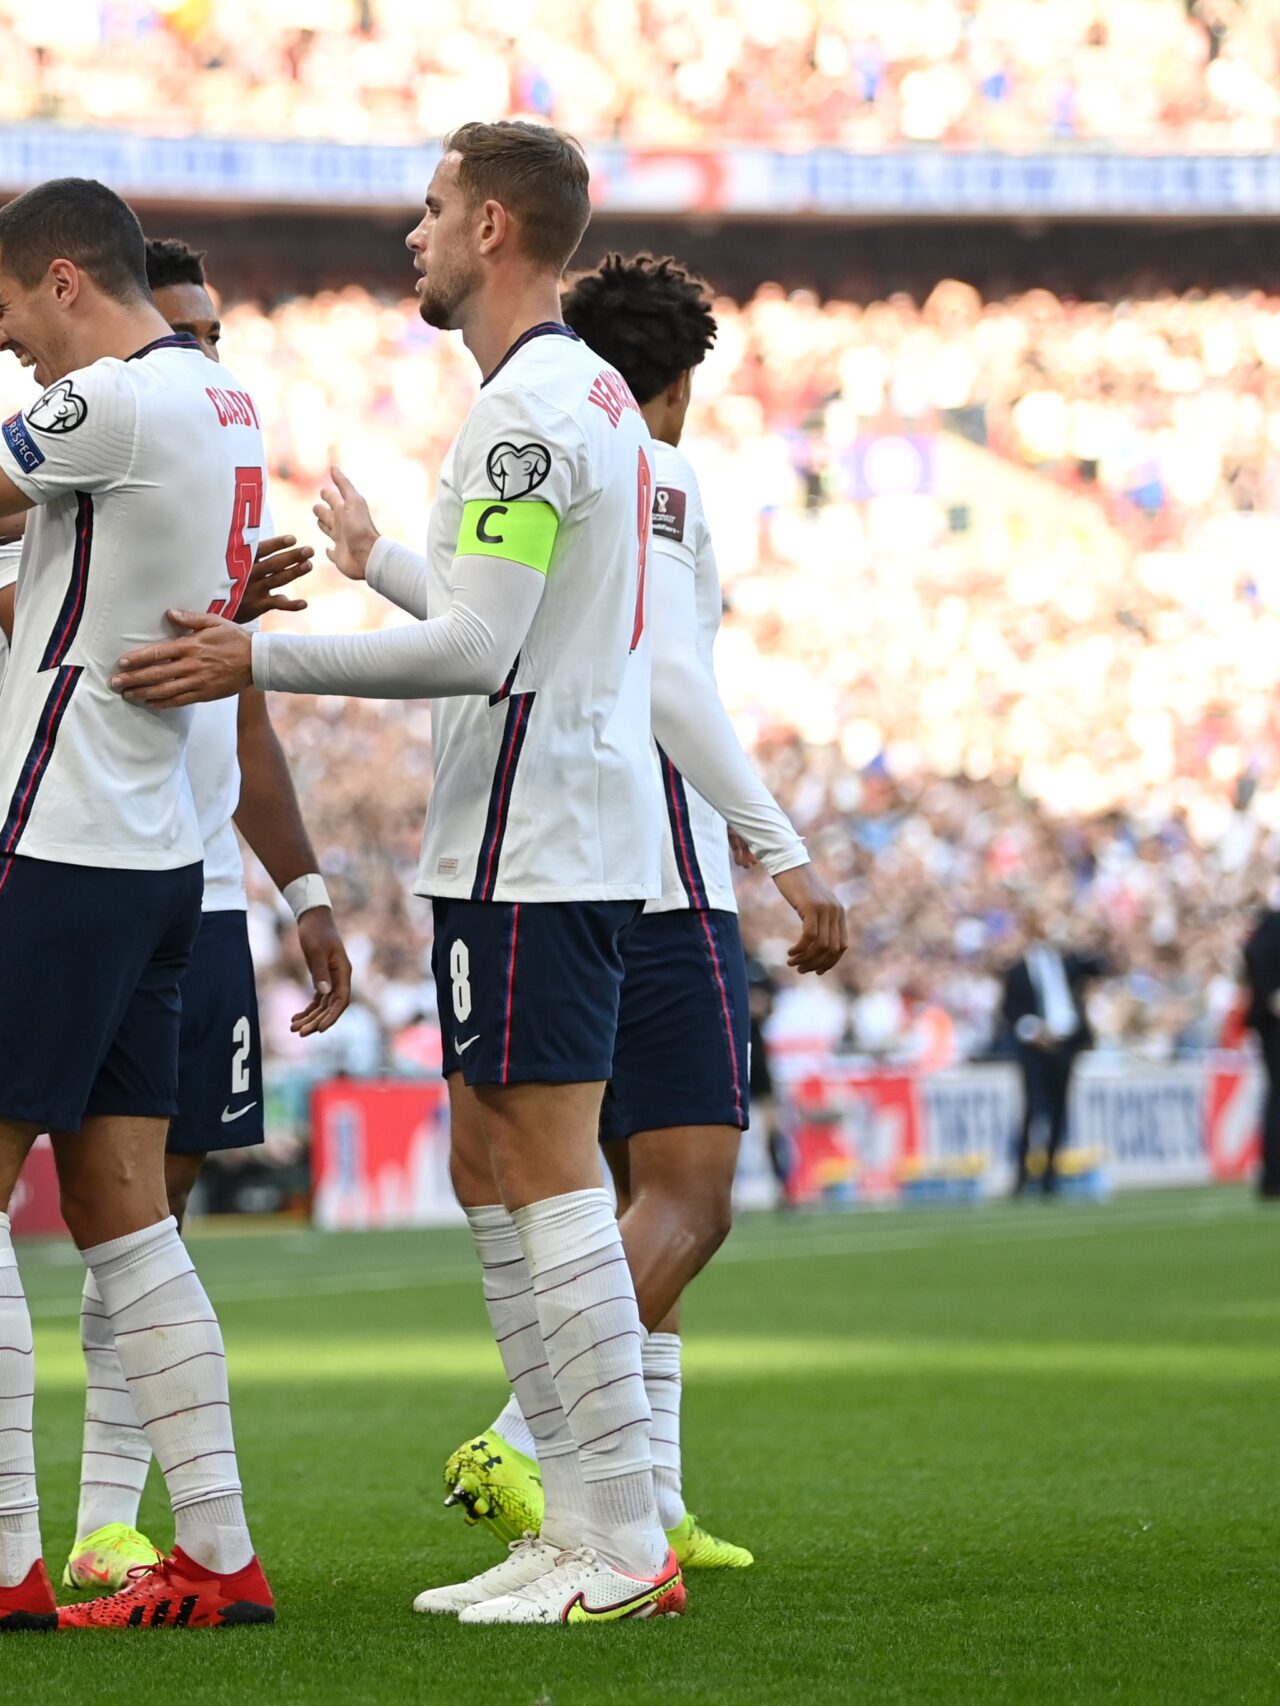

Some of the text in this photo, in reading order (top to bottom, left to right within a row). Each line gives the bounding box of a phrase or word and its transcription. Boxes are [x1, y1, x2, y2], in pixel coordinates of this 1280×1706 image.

[205, 386, 260, 430] COADY
[7, 421, 40, 467] RESPECT
[476, 505, 508, 544] C
[450, 938, 472, 1023] 8
[231, 1015, 251, 1094] 2
